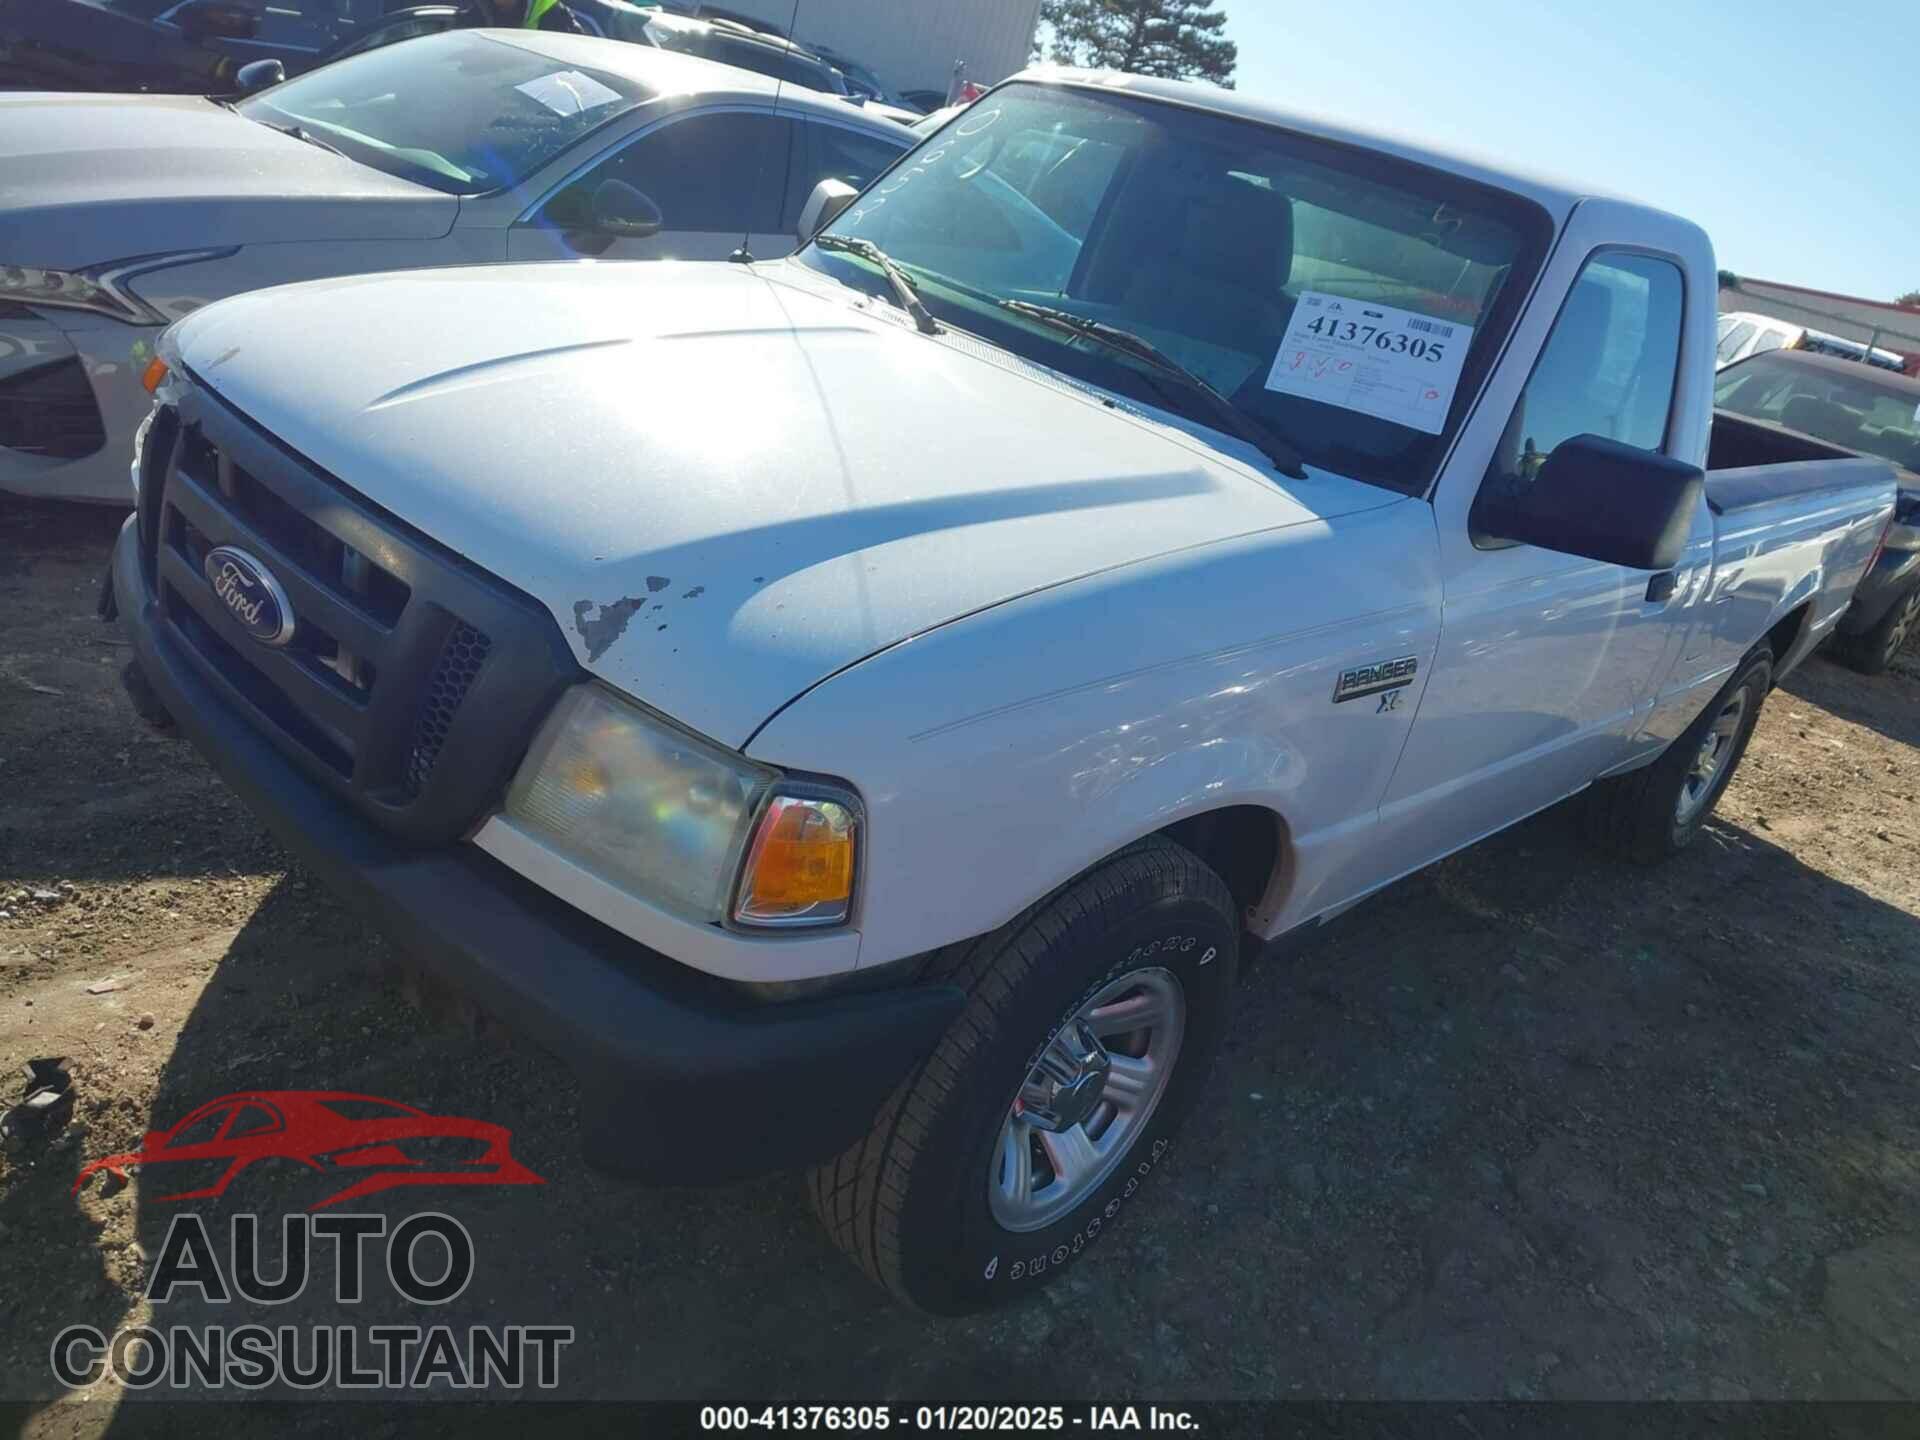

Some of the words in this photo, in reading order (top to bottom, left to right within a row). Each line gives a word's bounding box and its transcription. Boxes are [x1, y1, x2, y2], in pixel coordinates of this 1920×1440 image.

[1306, 314, 1445, 364] 41376305
[215, 561, 264, 625] Ford
[1341, 656, 1417, 690] RANGER
[1009, 1138, 1169, 1280] Firestone
